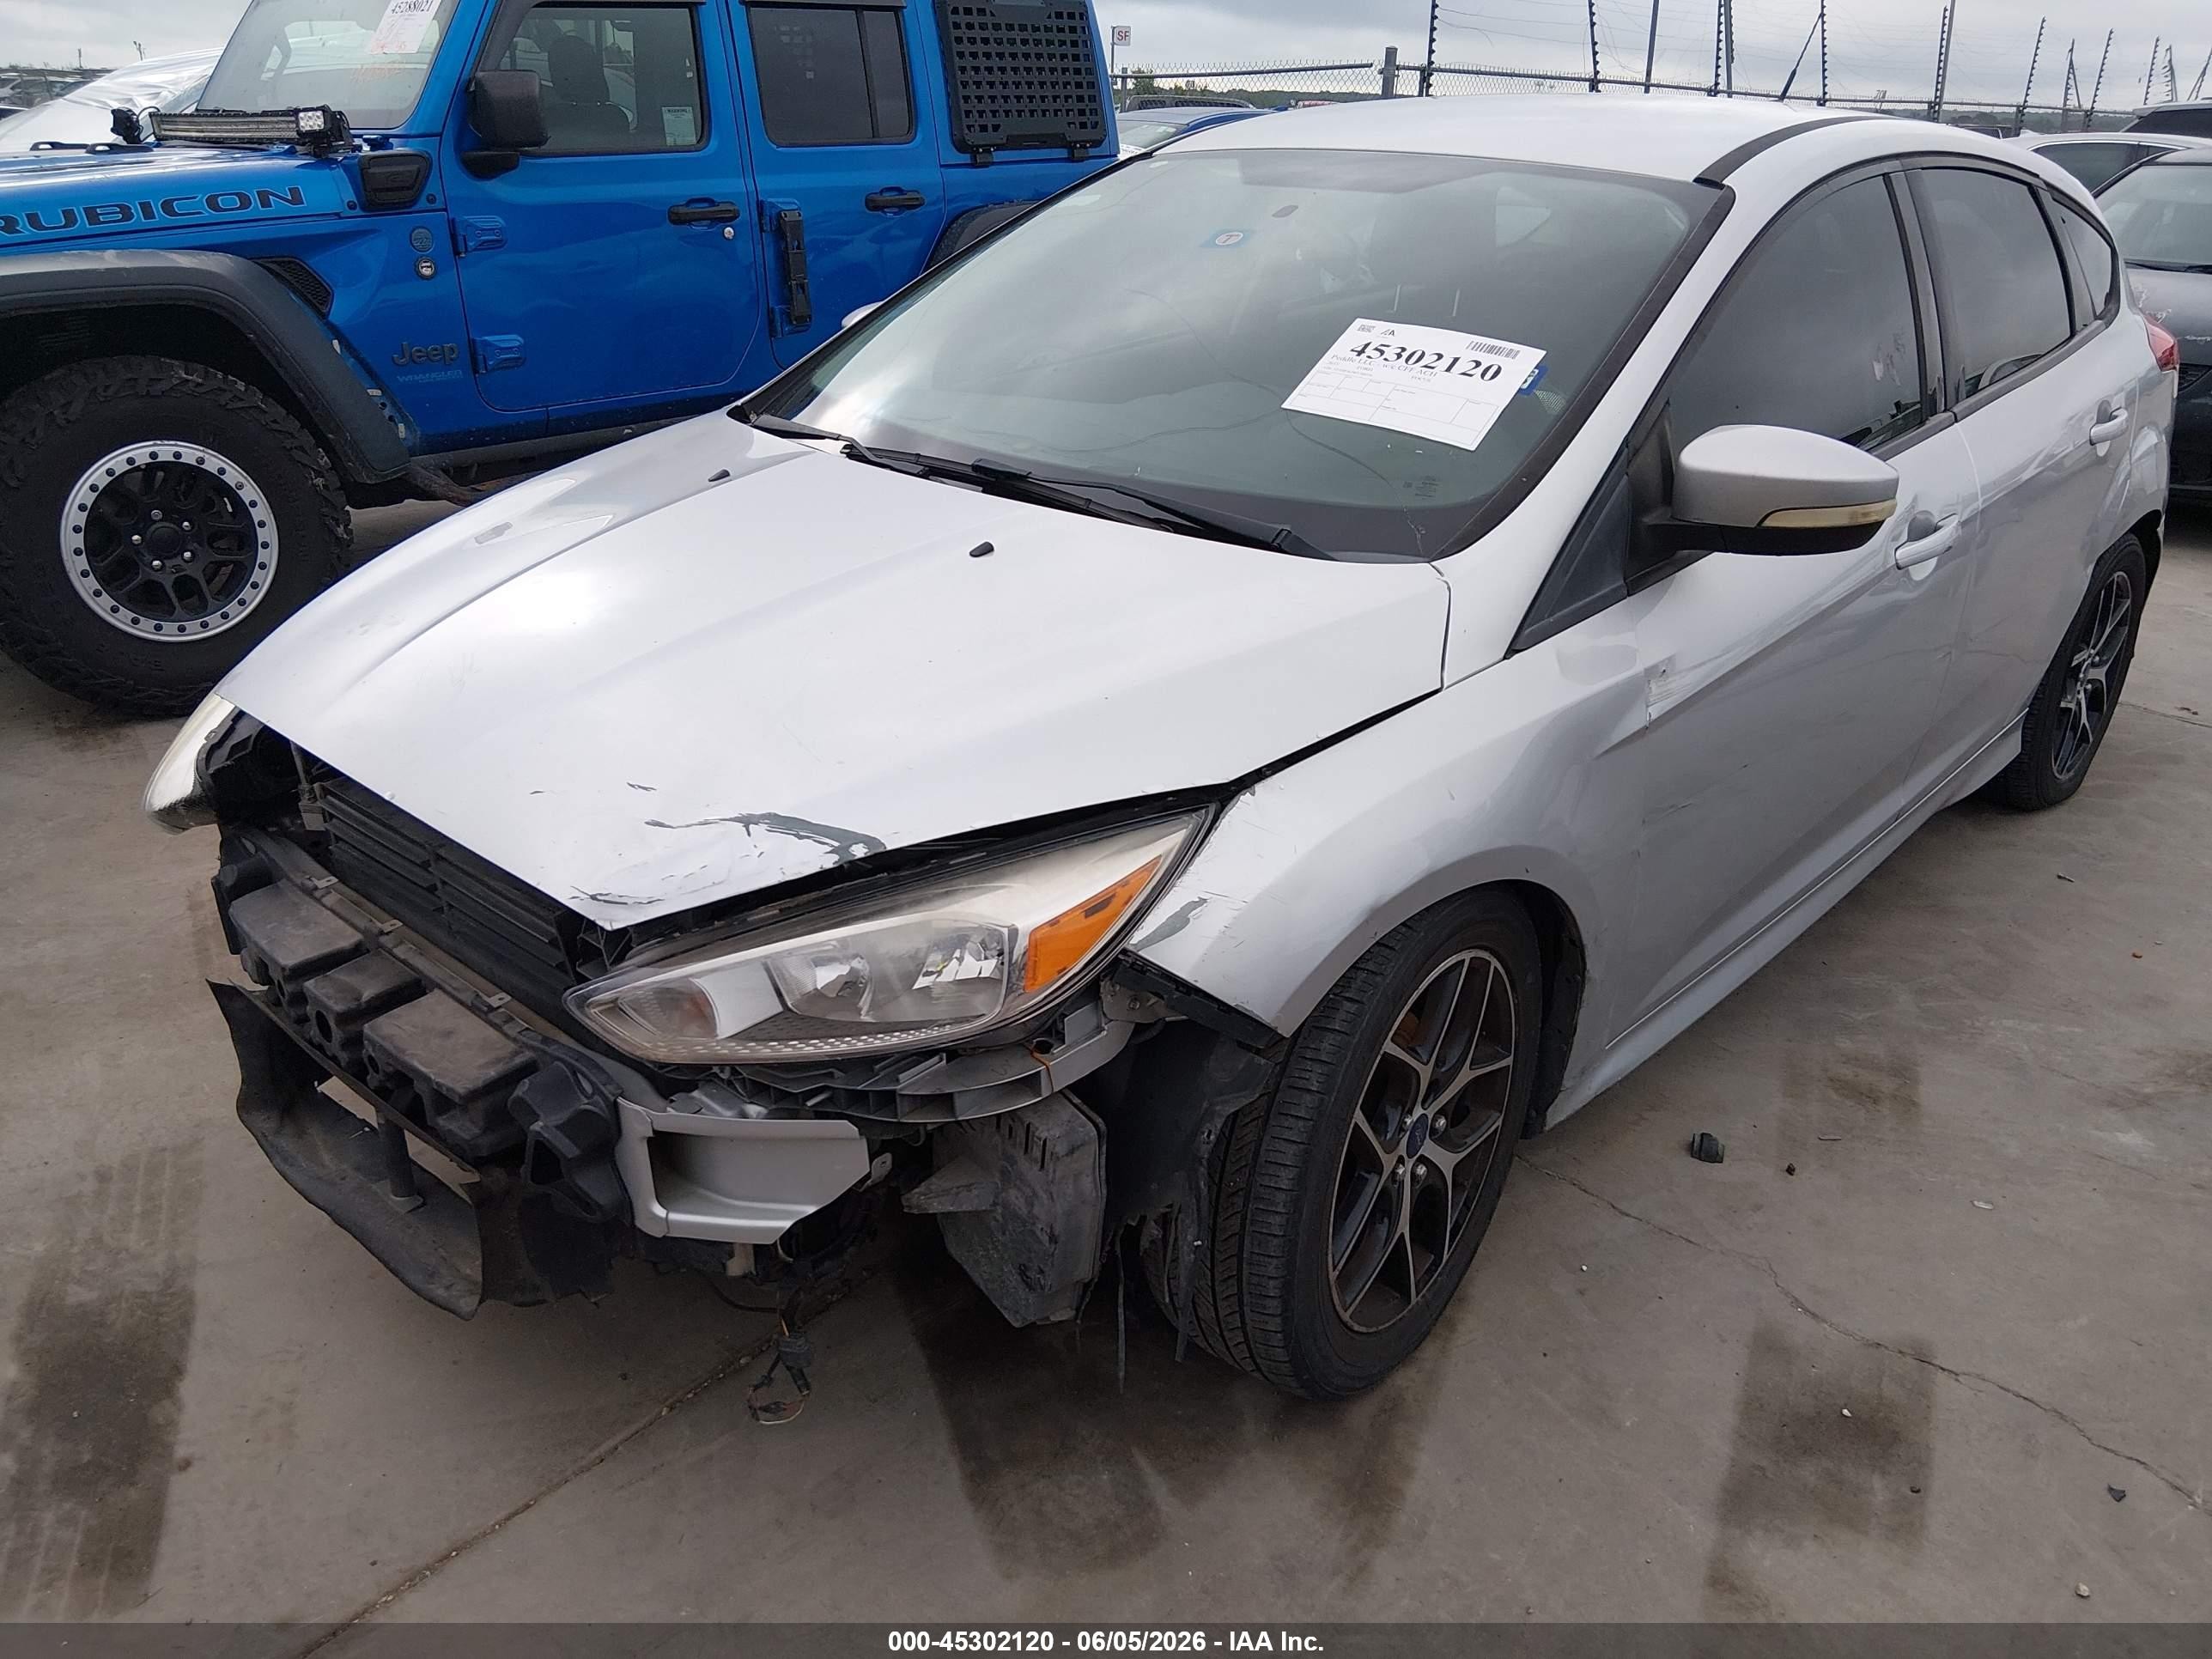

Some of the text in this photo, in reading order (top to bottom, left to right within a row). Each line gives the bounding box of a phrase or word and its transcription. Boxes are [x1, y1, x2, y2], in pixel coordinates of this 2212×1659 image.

[1117, 31, 1129, 41] SF
[392, 342, 459, 366] Jeep
[1350, 342, 1502, 381] 45302120
